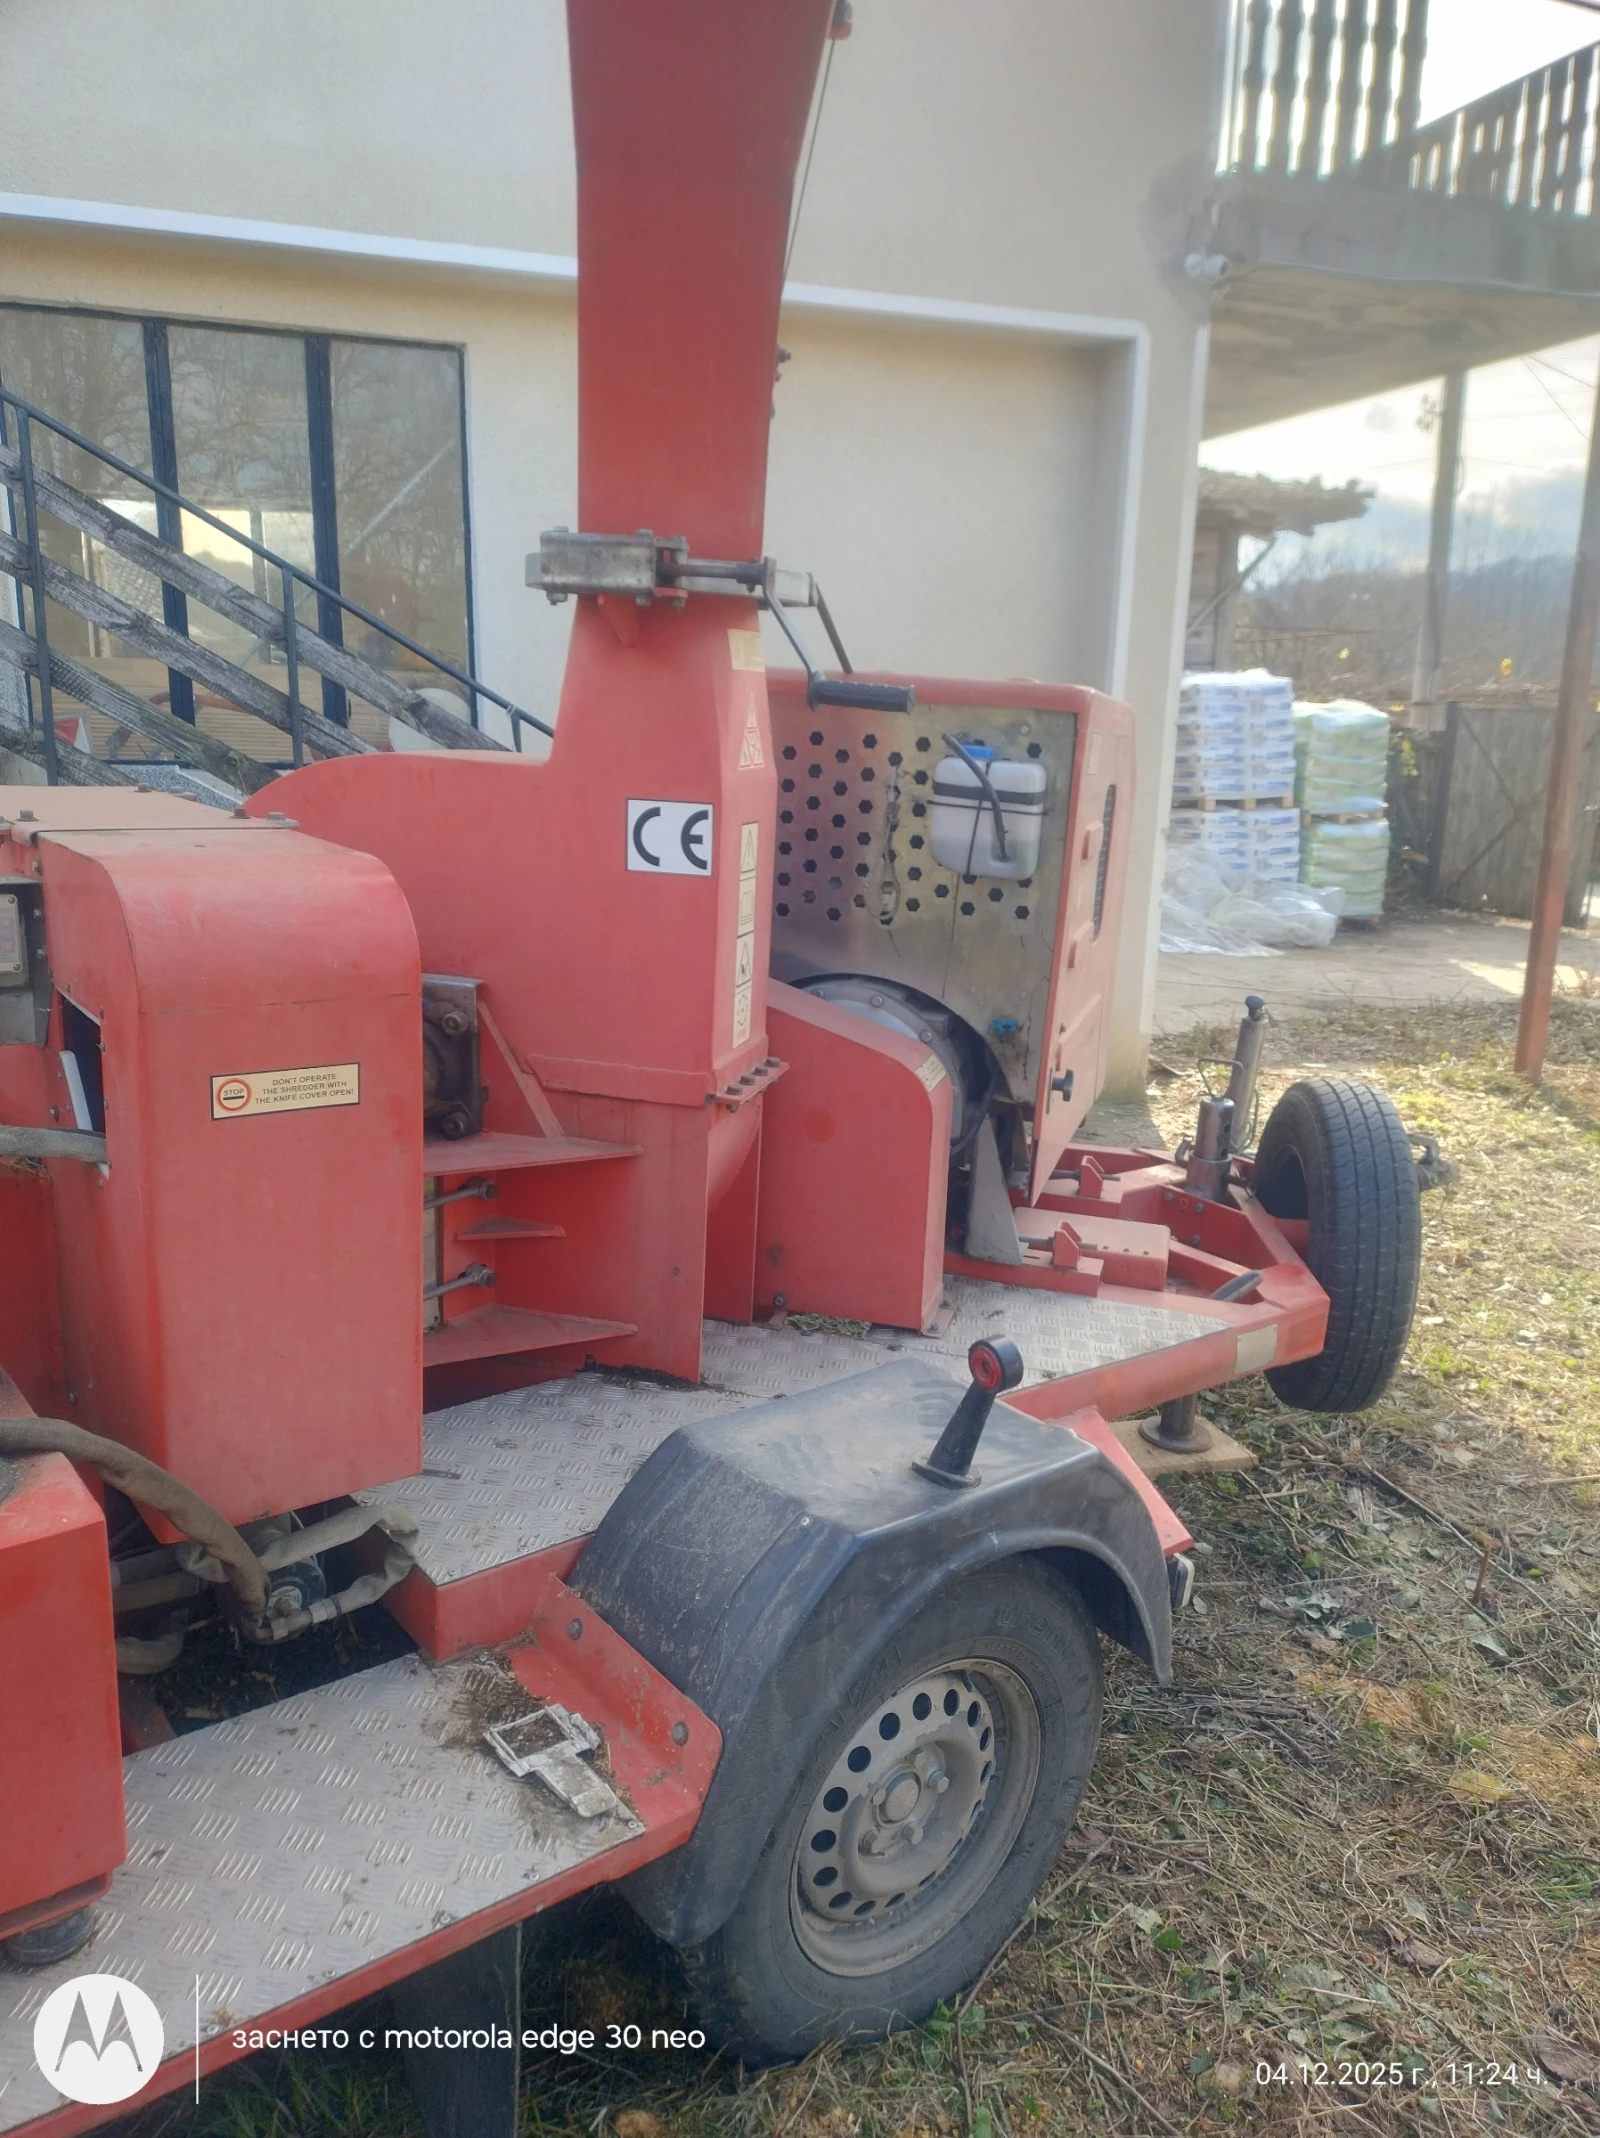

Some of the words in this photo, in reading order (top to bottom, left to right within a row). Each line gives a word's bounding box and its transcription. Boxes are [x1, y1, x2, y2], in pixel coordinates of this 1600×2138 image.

[633, 806, 709, 870] CE
[272, 1077, 297, 1086] DON'T
[299, 1073, 337, 1083] OPERATE
[223, 1088, 244, 1096] STOP
[262, 1087, 279, 1095] THE
[280, 1082, 325, 1094] SHREDDER
[327, 1081, 347, 1089] WITH
[255, 1096, 271, 1105] THE
[273, 1094, 297, 1103] KNIFE
[299, 1090, 328, 1100] COVER
[329, 1088, 354, 1097] OPEN!
